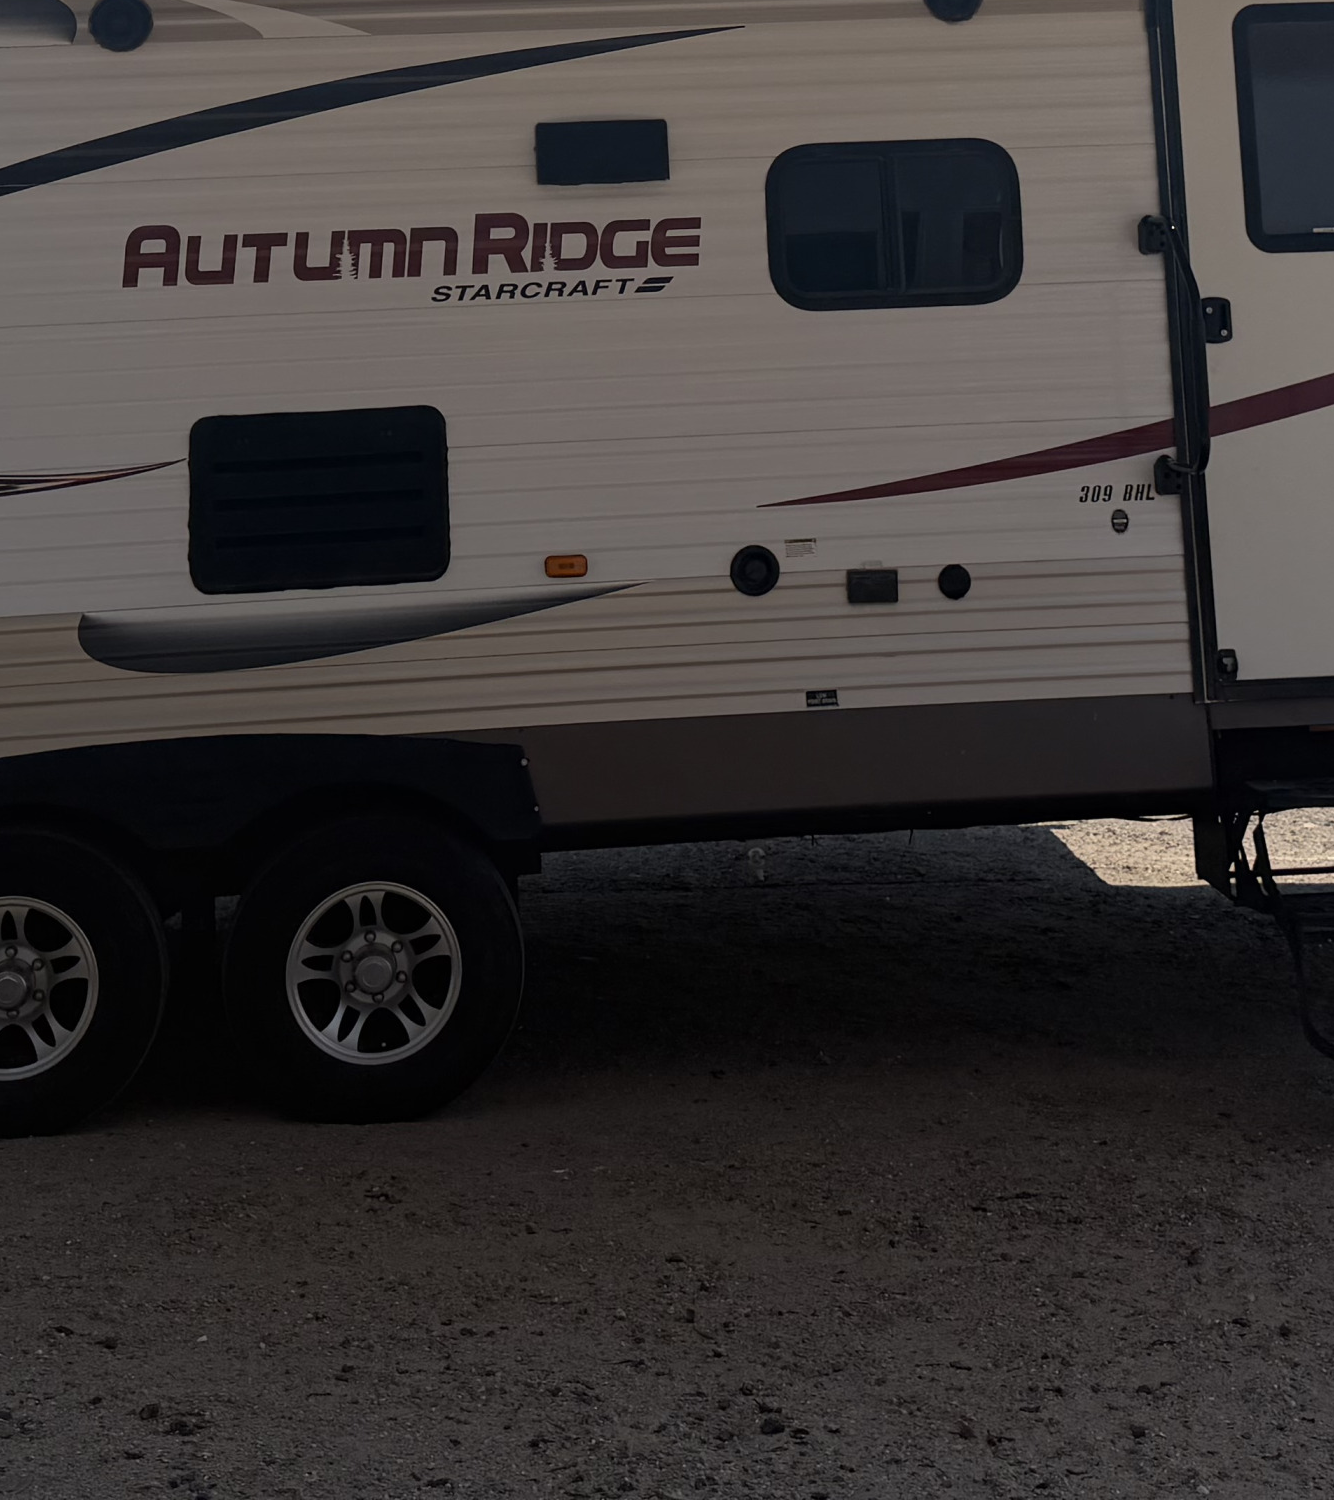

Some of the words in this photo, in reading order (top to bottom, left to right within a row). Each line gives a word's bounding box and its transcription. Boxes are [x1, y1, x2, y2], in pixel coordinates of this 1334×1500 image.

[430, 278, 630, 303] STARCRAFT
[1079, 485, 1113, 503] 309
[1123, 484, 1155, 501] BHL
